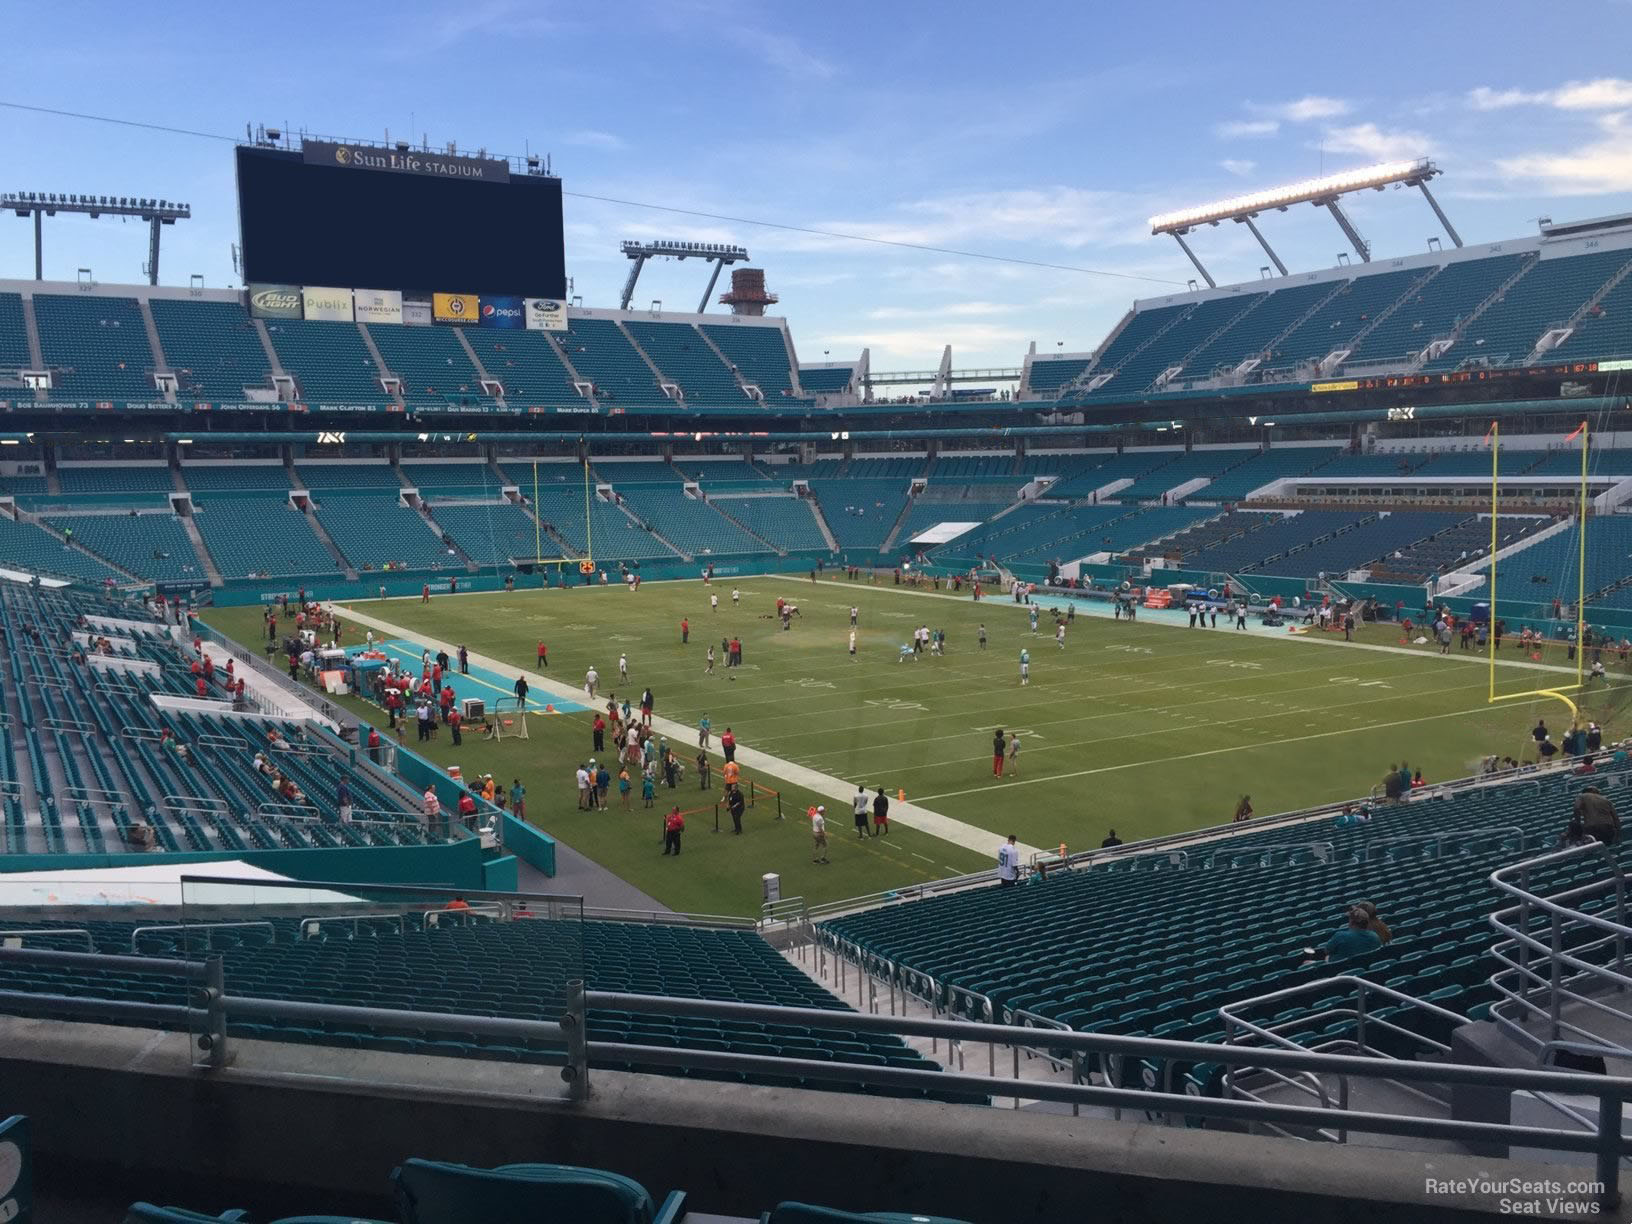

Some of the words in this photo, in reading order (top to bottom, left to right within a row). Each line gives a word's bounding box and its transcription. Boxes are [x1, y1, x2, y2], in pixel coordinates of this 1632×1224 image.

[353, 150, 387, 167] Sun
[390, 154, 421, 171] Life
[425, 162, 483, 177] STADIUM
[265, 293, 298, 302] BUD
[259, 301, 300, 309] LIGHT
[306, 299, 348, 310] Publix
[537, 302, 556, 310] Ford
[496, 306, 521, 318] pepsi
[581, 562, 593, 572] 25
